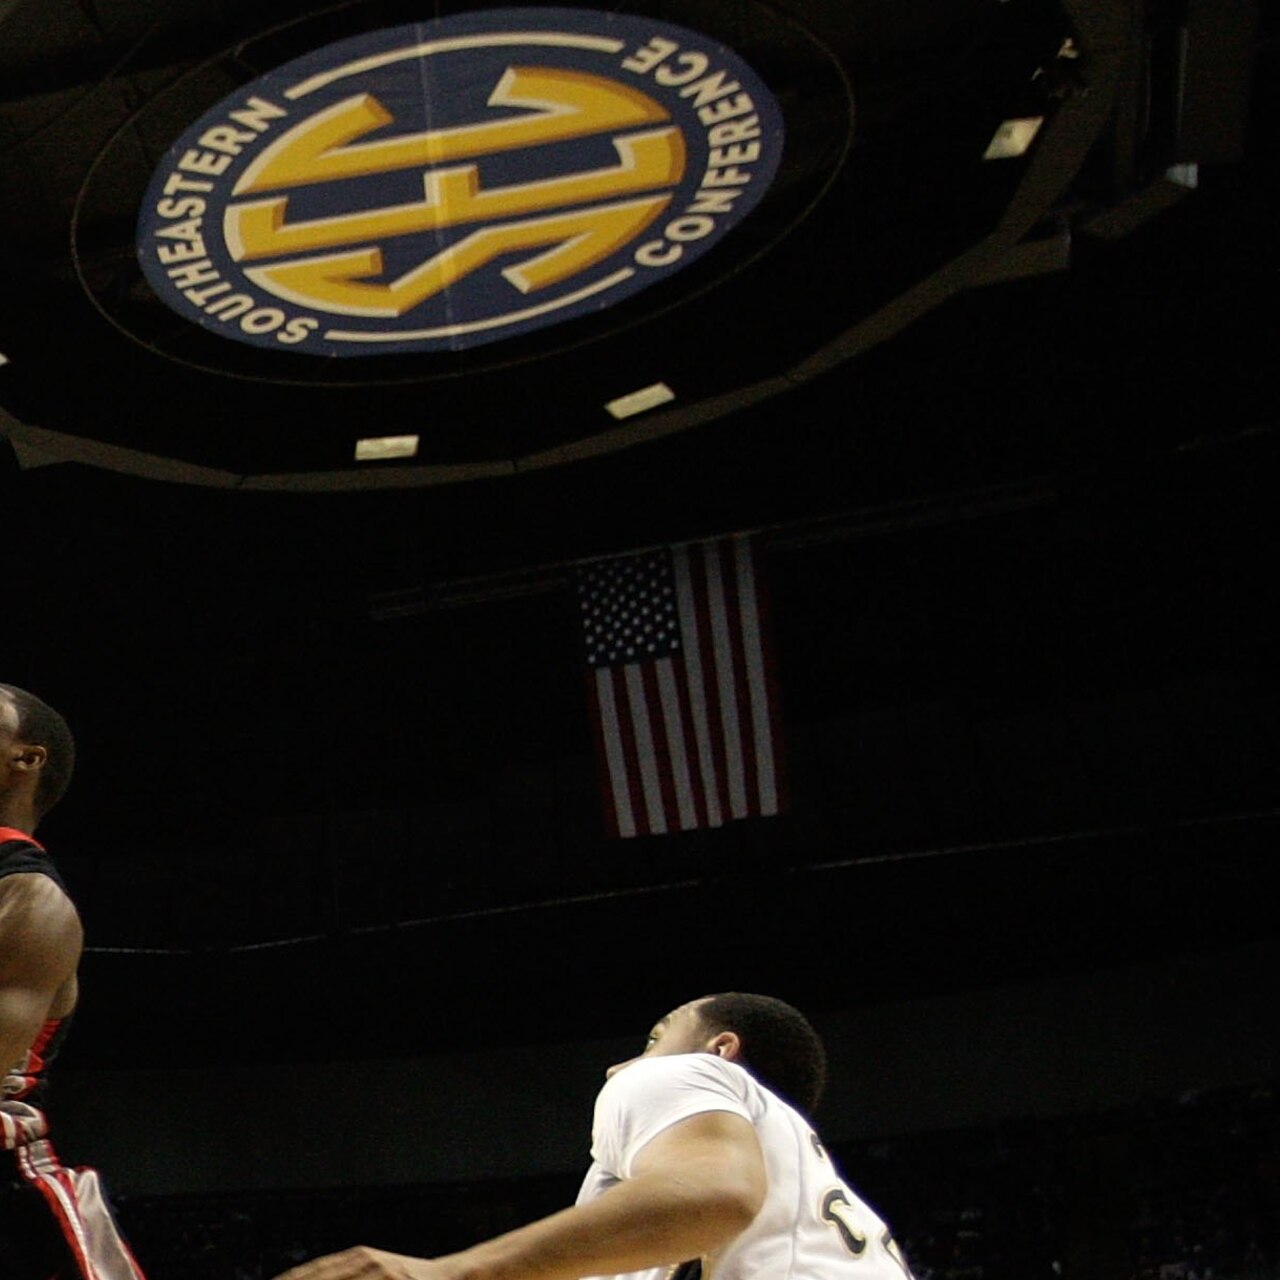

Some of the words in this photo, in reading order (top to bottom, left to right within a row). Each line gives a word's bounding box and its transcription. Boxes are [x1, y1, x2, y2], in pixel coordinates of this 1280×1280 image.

[155, 97, 319, 343] SOUTHEASTERN
[621, 37, 761, 266] CONFERENCE
[223, 67, 687, 316] SEC
